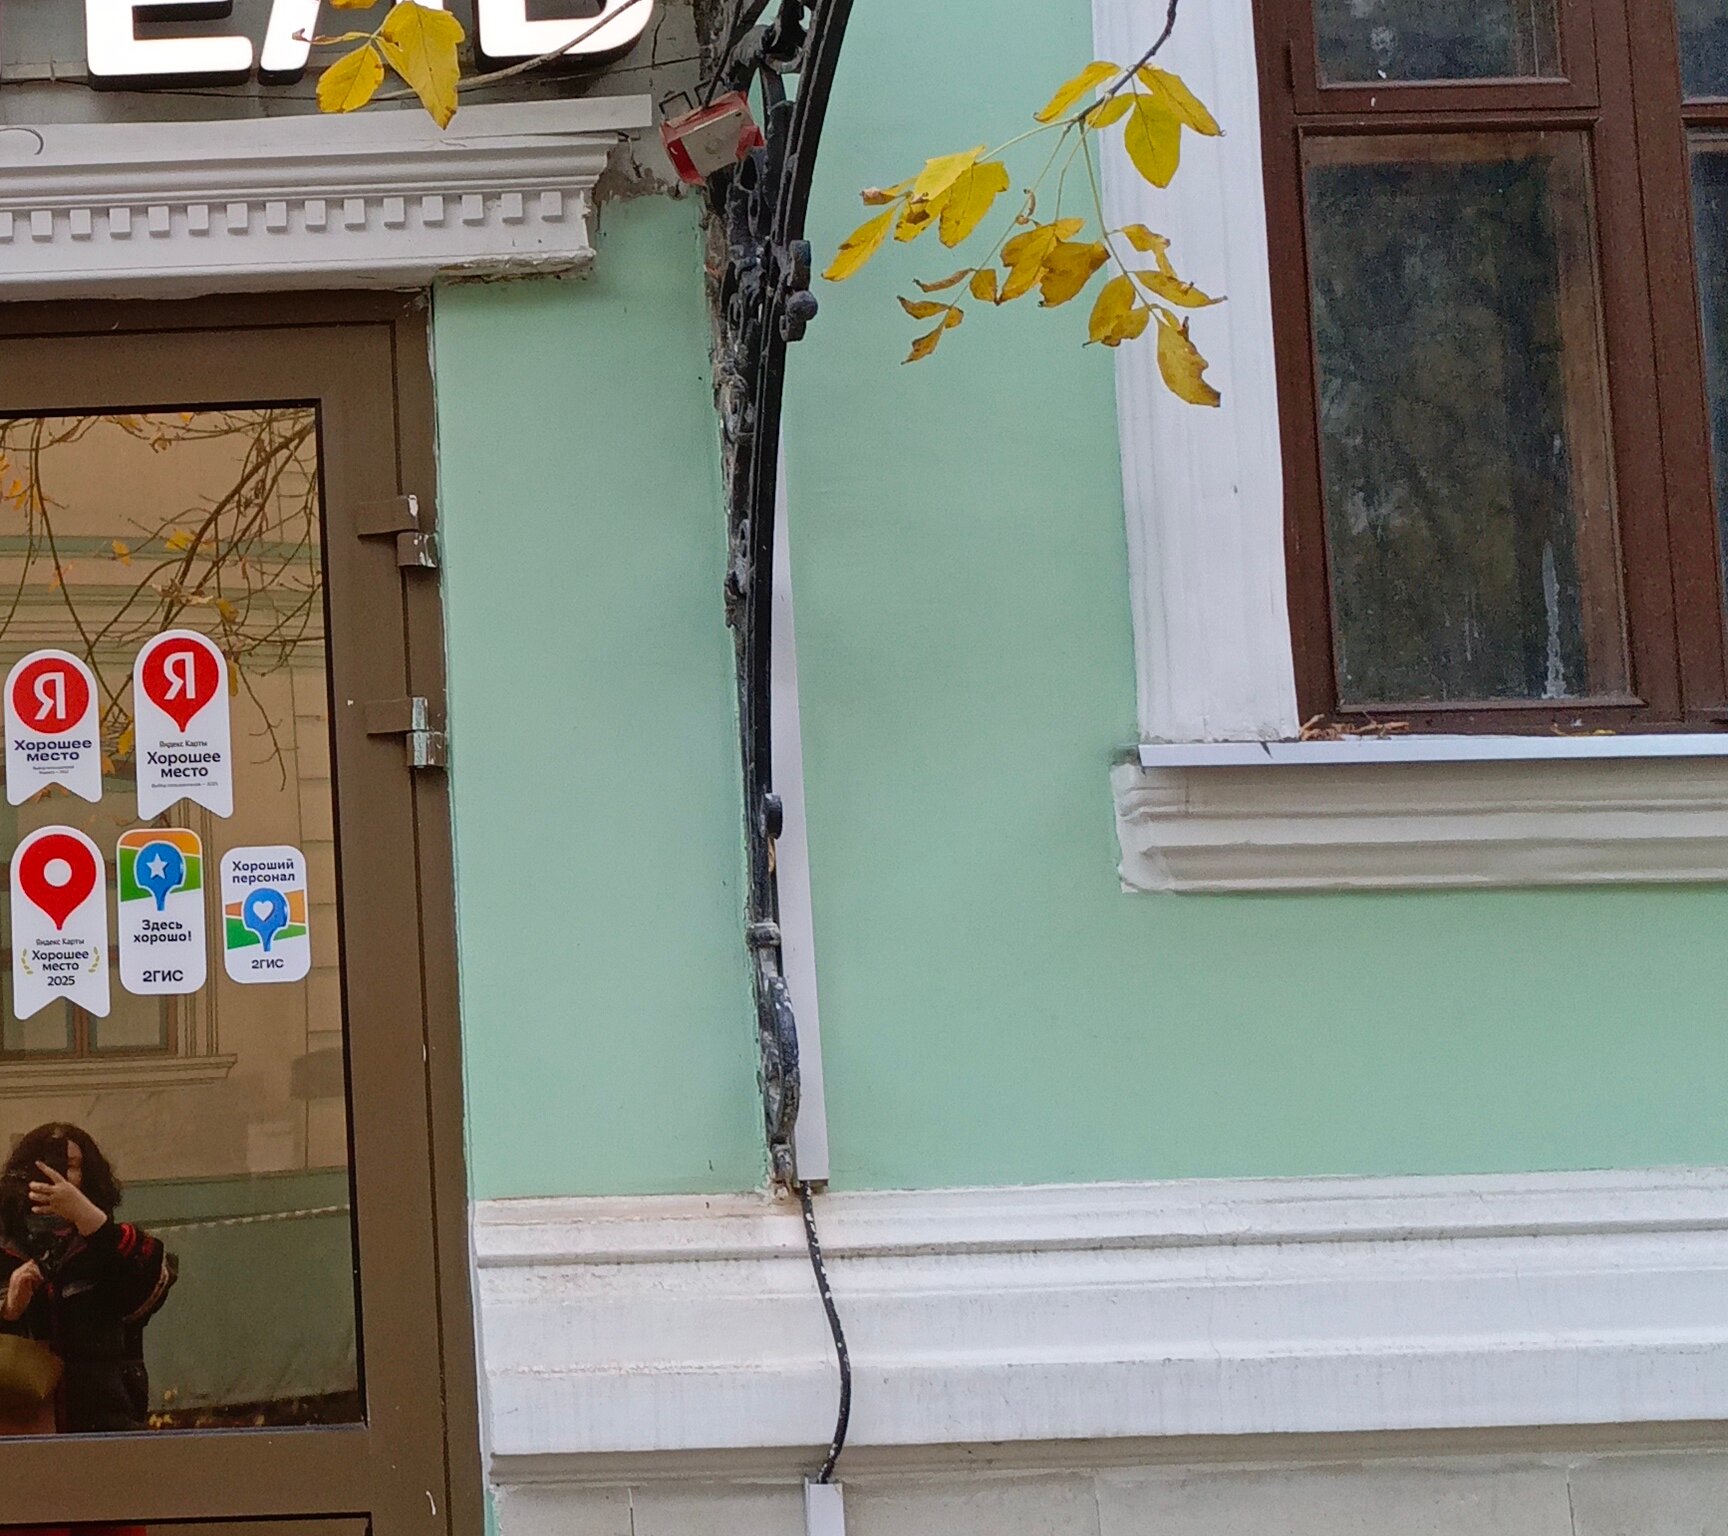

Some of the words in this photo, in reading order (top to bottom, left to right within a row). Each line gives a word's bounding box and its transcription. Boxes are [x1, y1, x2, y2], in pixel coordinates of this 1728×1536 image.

[162, 650, 197, 701] Я
[33, 671, 67, 721] Я
[13, 739, 93, 752] Хорошее
[184, 739, 208, 748] Карты
[26, 751, 80, 762] место
[147, 750, 221, 766] Хорошее
[160, 766, 209, 778] место
[232, 859, 295, 873] Хороший
[232, 872, 296, 886] персонал
[141, 919, 183, 932] Здесь
[133, 930, 192, 945] хорошо!
[31, 949, 89, 962] Хорошее
[42, 962, 80, 972] место
[251, 959, 285, 970] 2ГИС
[47, 975, 76, 986] 2025
[142, 970, 184, 983] 2ГИС
